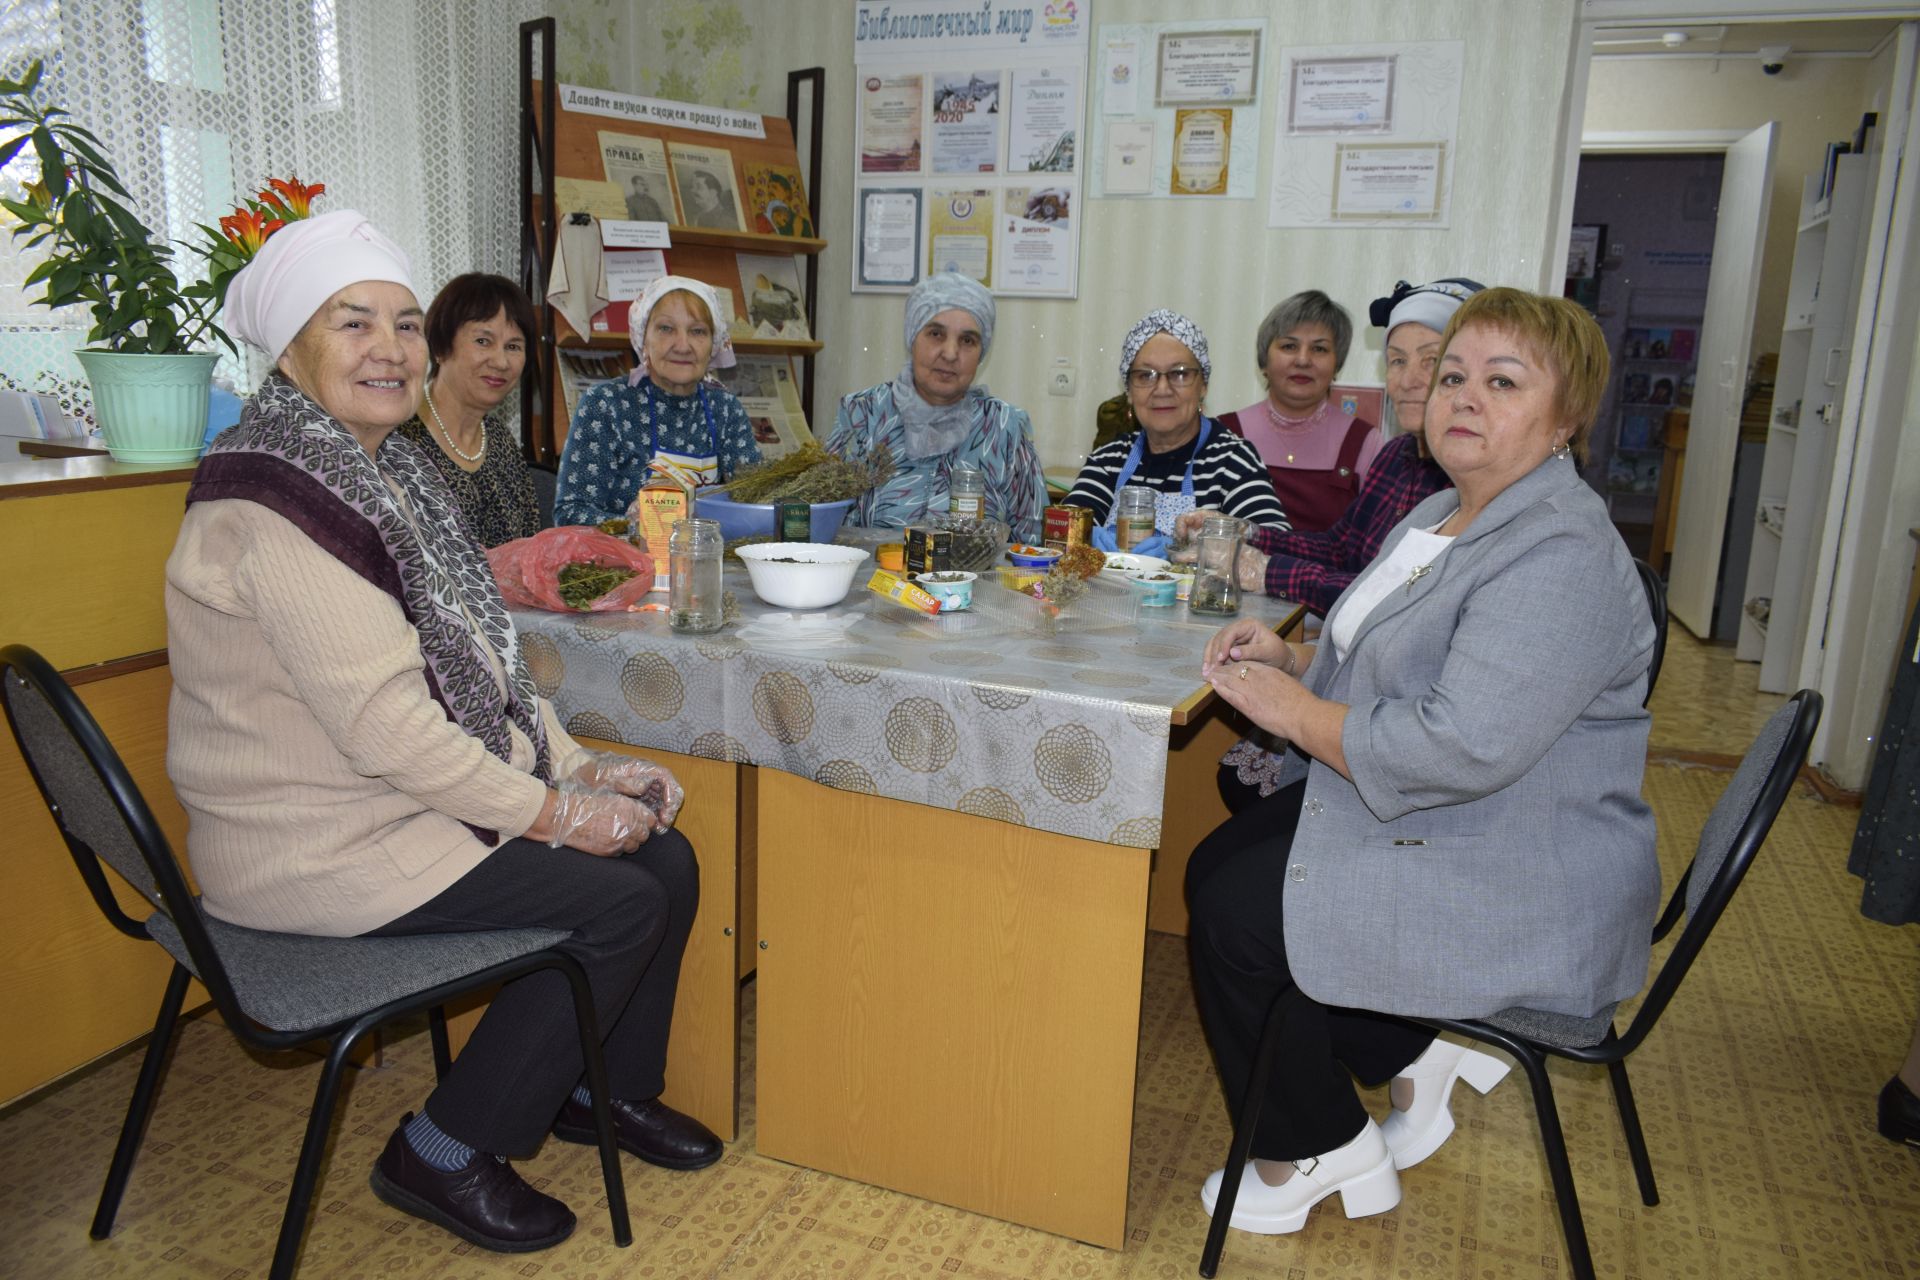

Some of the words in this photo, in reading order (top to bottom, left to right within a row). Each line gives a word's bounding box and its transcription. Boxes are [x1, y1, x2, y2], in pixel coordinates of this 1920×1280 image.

[856, 1, 991, 41] Библиотечный
[996, 8, 1033, 43] мир
[568, 90, 610, 109] Давайте
[613, 101, 648, 115] внукам
[651, 106, 686, 121] скажем
[690, 111, 722, 128] правду
[724, 117, 730, 127] о
[732, 117, 757, 131] войне
[946, 101, 976, 113] 1945
[933, 111, 964, 124] 2020
[605, 148, 645, 162] ПРАВДА
[645, 498, 681, 506] ASANTEA
[911, 588, 936, 606] САХАР
